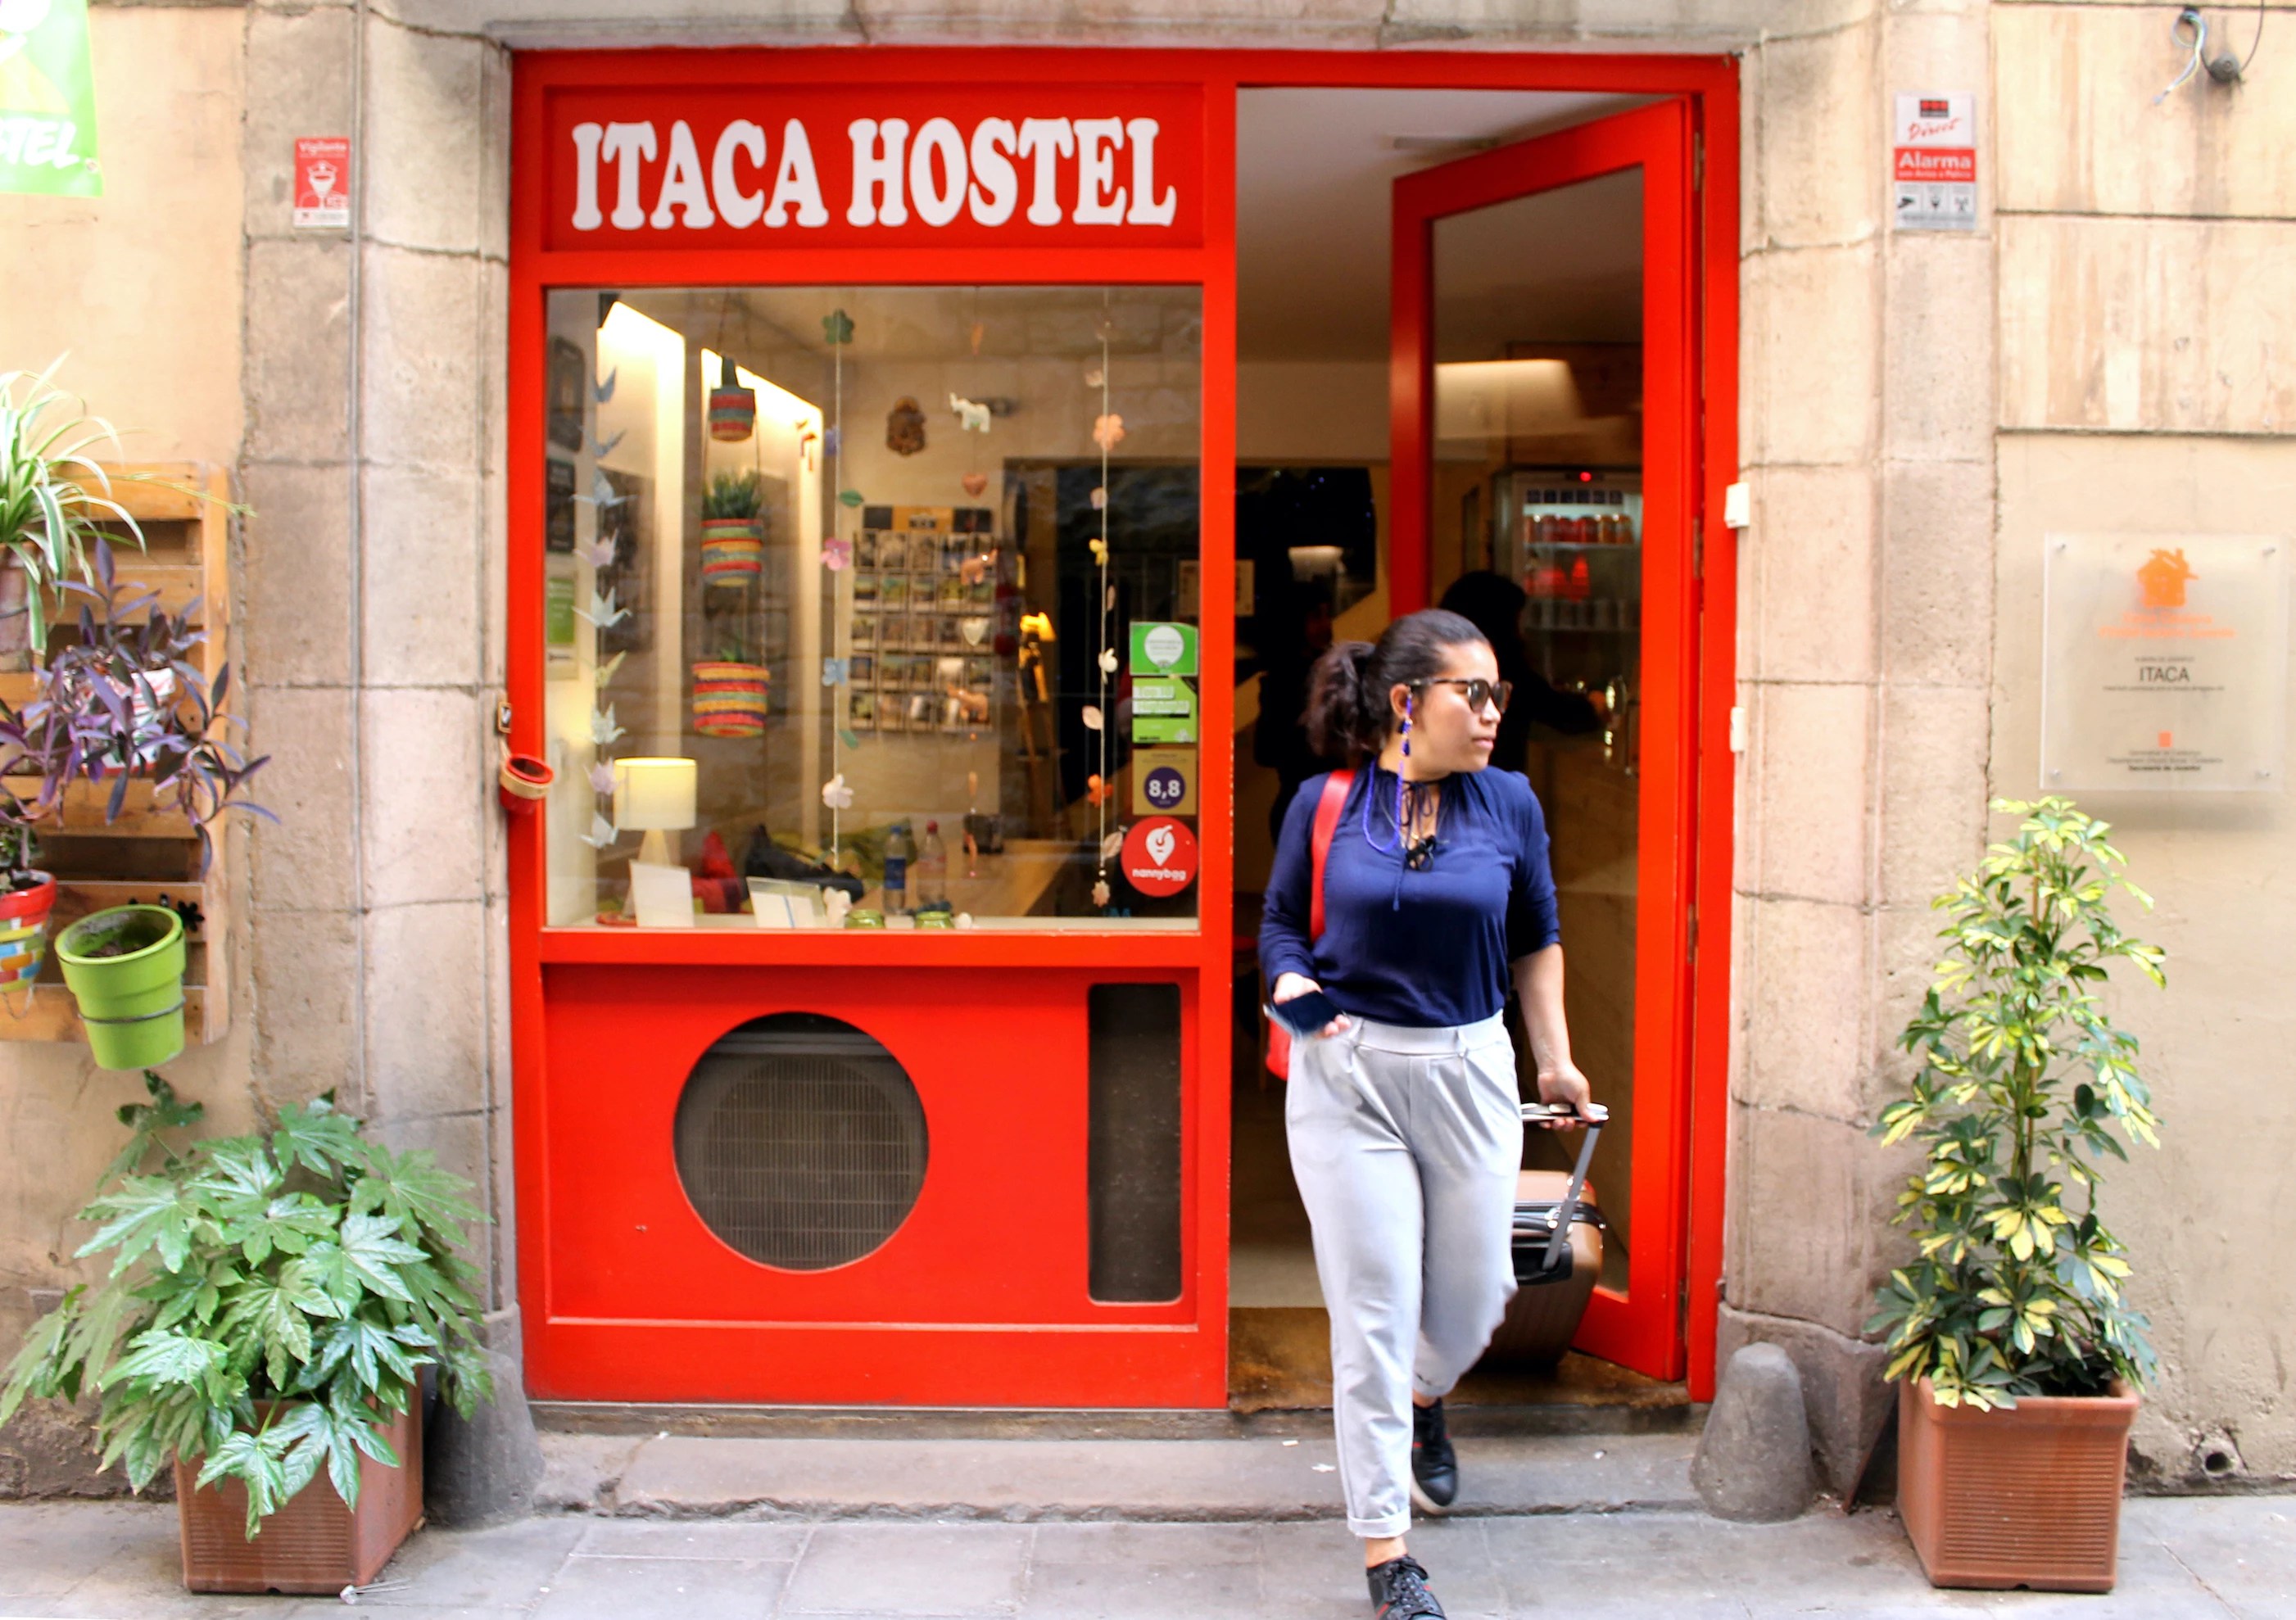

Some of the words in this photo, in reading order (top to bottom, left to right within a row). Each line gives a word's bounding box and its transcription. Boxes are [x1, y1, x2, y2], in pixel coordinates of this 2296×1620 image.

[0, 115, 80, 170] TEL
[1899, 151, 1972, 169] Alarma
[572, 119, 829, 230] ITACA
[846, 116, 1177, 227] HOSTEL
[2139, 666, 2190, 683] ITACA
[1148, 779, 1180, 800] 8,8
